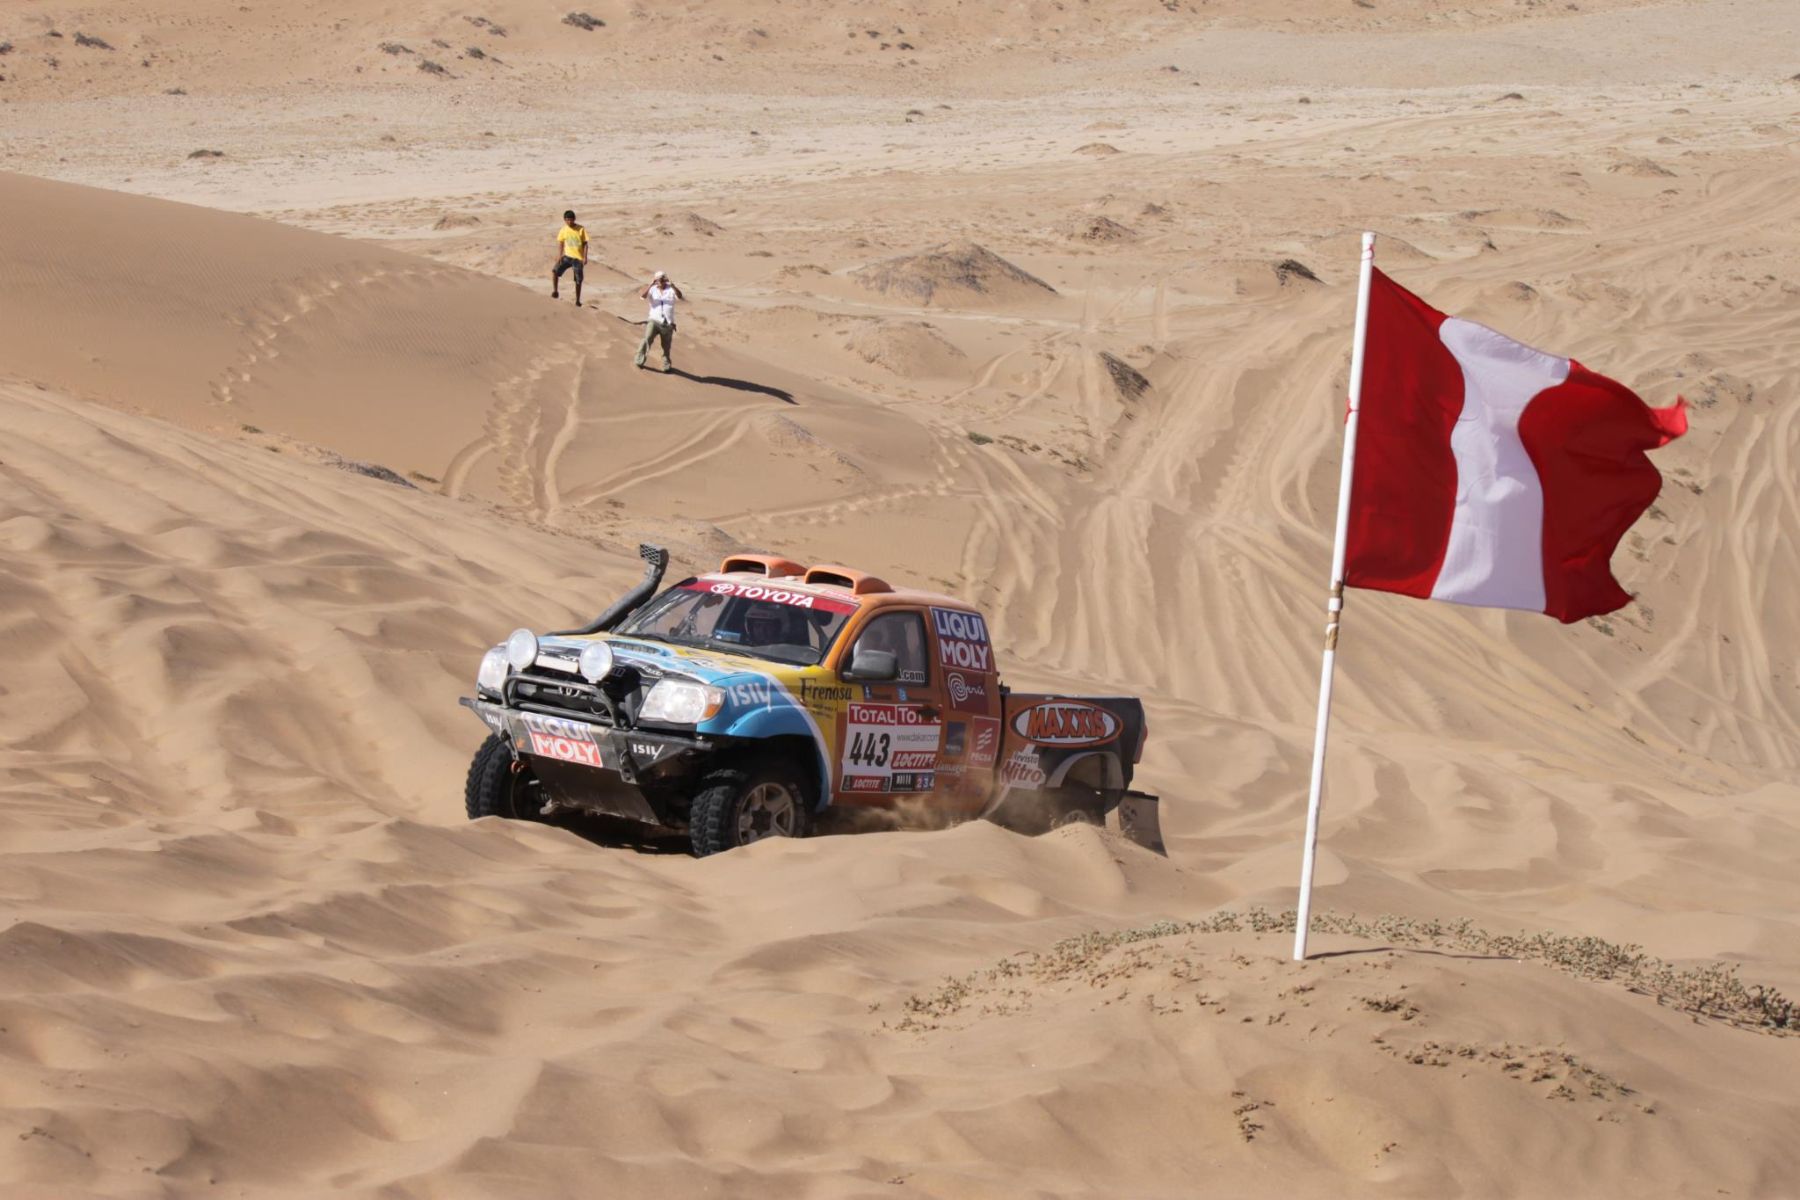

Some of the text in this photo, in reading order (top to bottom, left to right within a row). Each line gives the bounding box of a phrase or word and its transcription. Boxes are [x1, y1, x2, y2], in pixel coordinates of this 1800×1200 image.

[735, 585, 815, 608] TOYOTA
[934, 610, 987, 641] LIQUI
[940, 639, 988, 669] MOLY
[799, 677, 852, 700] Frenosa
[850, 705, 895, 723] TOTAL
[1026, 707, 1107, 739] MAXXIS
[526, 715, 591, 742] LIQUI
[536, 734, 597, 763] MOLY
[849, 732, 890, 767] 443
[893, 753, 936, 769] LOCTITE
[1001, 760, 1041, 784] Nitro
